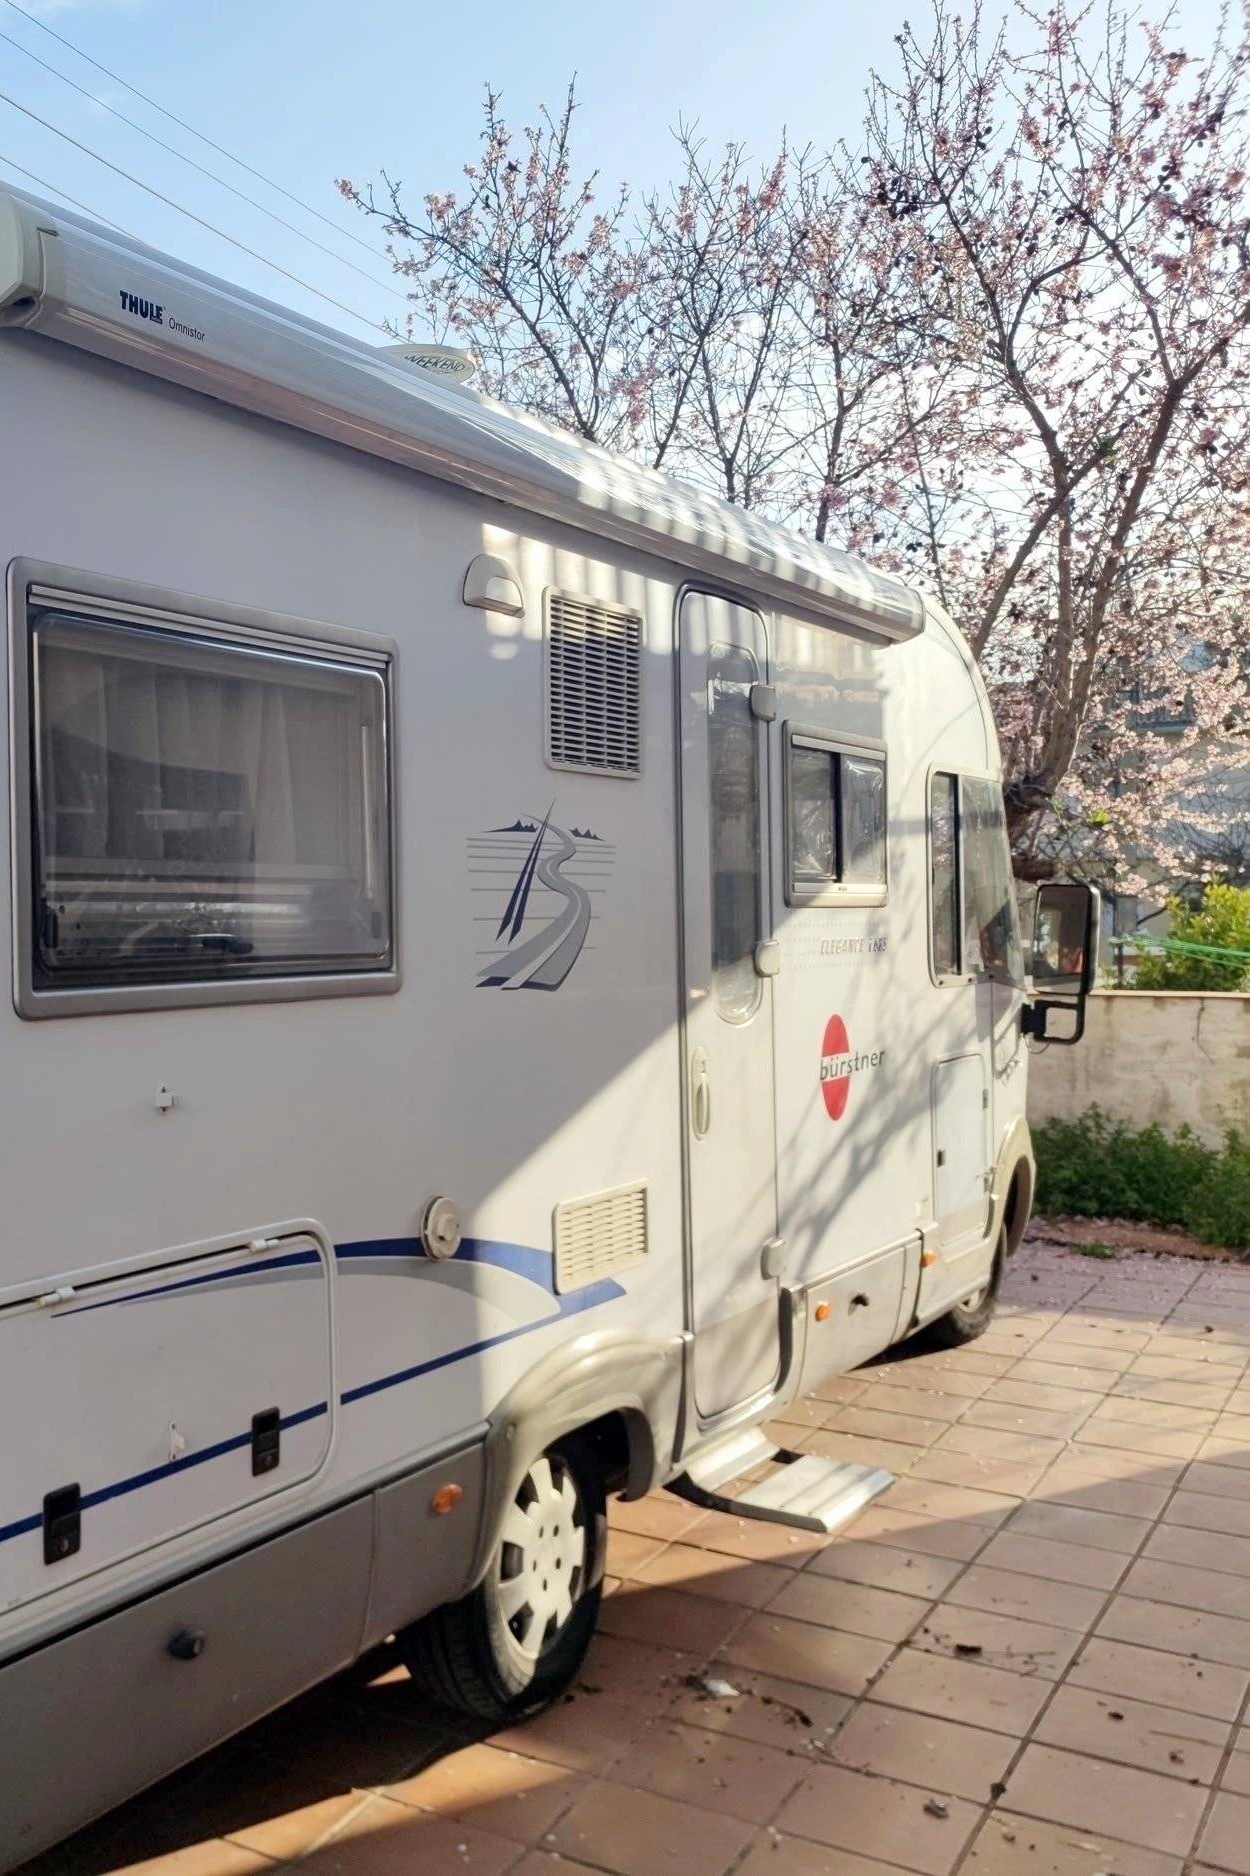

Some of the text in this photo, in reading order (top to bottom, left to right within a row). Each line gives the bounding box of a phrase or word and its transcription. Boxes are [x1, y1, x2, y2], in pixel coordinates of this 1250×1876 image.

[119, 289, 206, 342] THULE Omnistor
[403, 354, 466, 372] WEEKEND
[820, 1049, 886, 1081] bürstner
